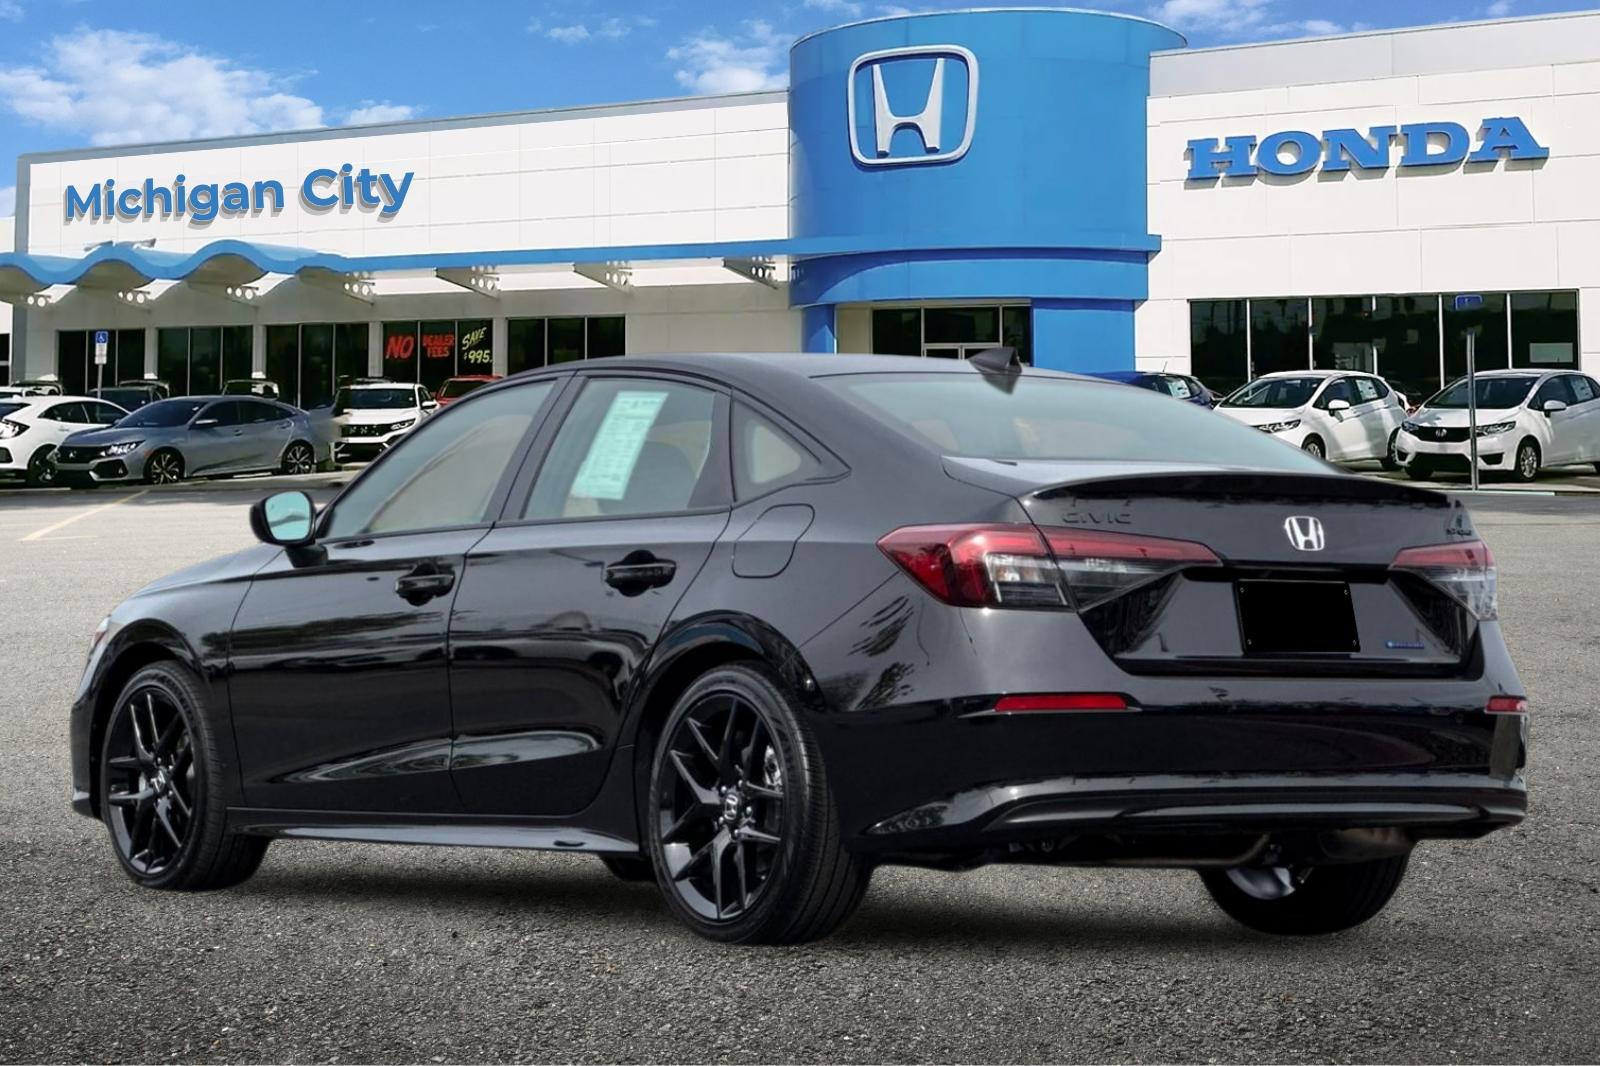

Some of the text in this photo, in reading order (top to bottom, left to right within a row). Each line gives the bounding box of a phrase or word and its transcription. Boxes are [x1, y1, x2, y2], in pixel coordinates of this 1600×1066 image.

[1186, 116, 1550, 181] HONDA
[65, 163, 414, 222] Michigan City
[385, 335, 415, 359] NO
[461, 327, 487, 350] SAVE
[1062, 512, 1132, 525] CIVIC
